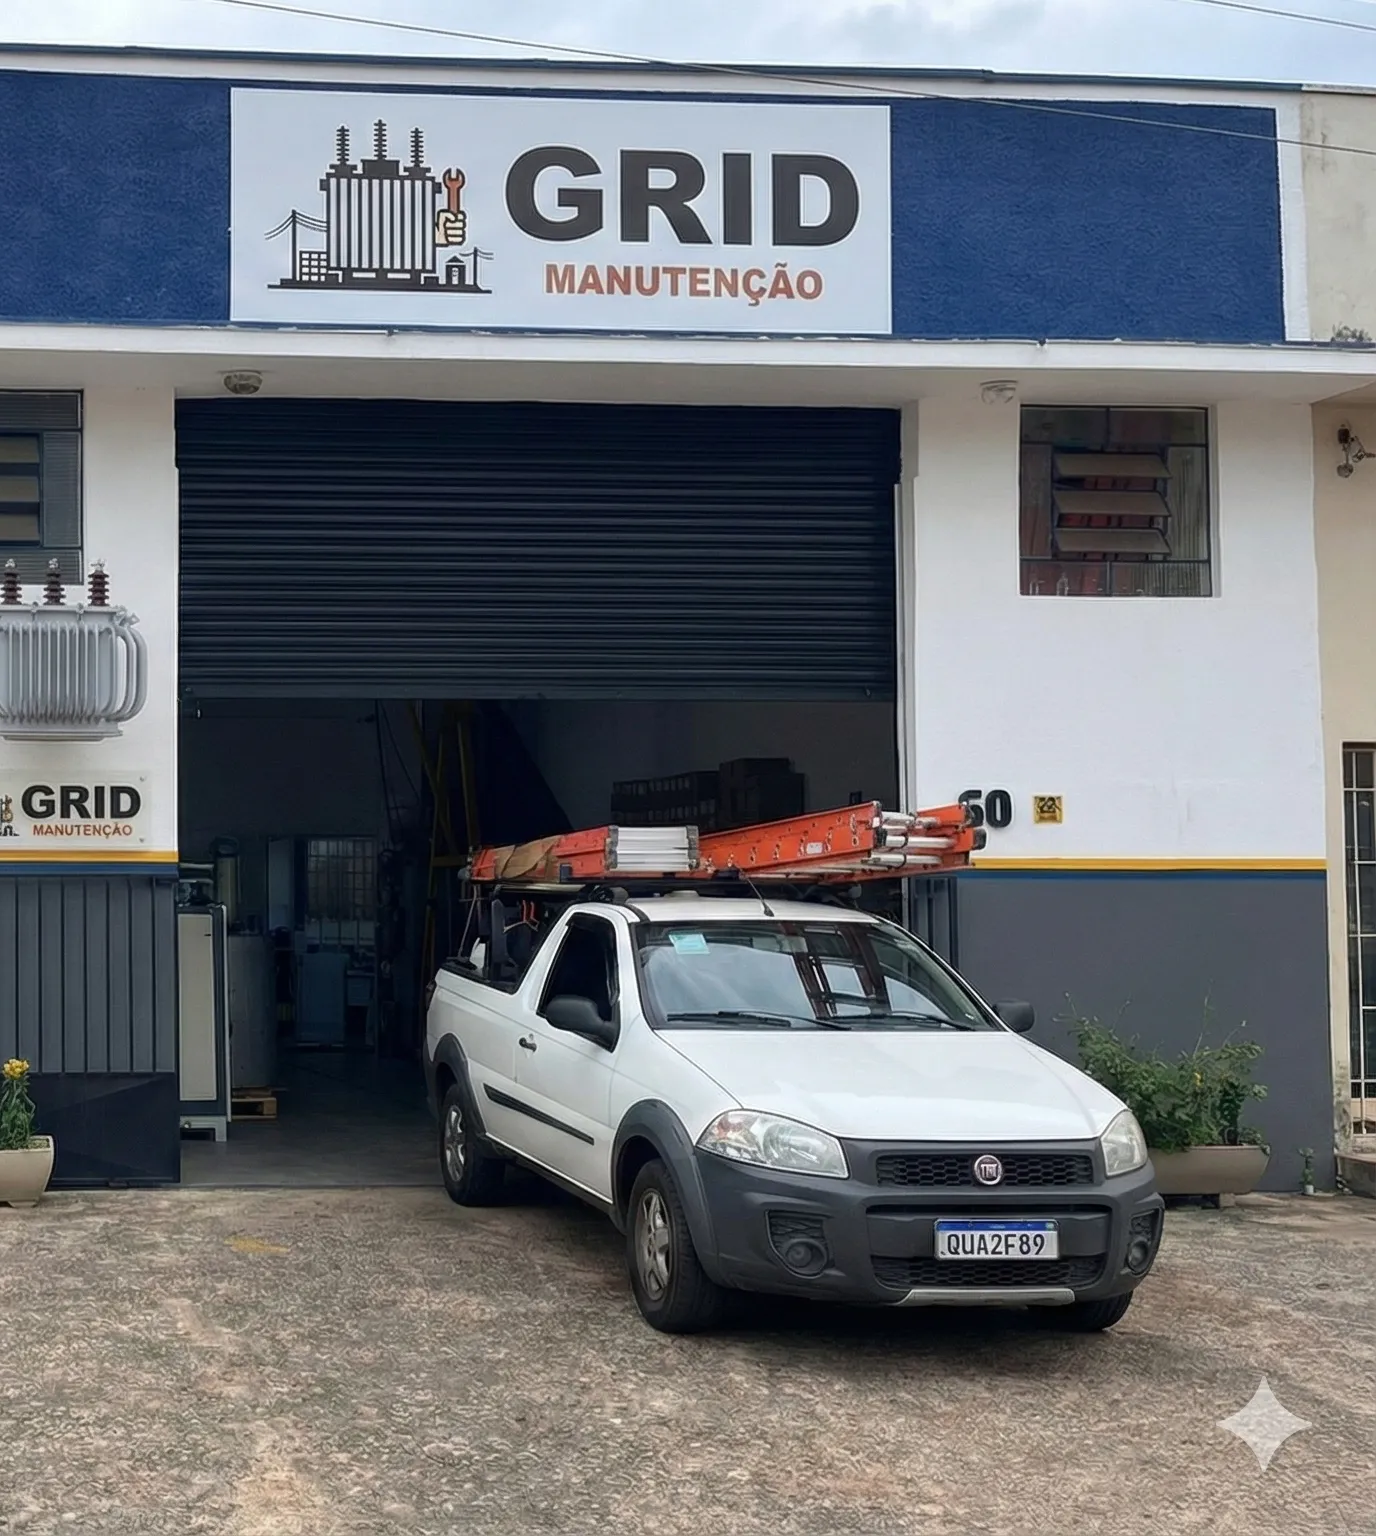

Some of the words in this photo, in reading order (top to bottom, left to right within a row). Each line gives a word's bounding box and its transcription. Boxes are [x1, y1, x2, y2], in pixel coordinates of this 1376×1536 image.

[505, 145, 860, 246] GRID
[545, 261, 824, 306] MANUTENÇÃO
[21, 785, 142, 819] GRID
[32, 822, 133, 839] MANUTENÇÃO
[947, 1233, 1046, 1255] QUA2F89
